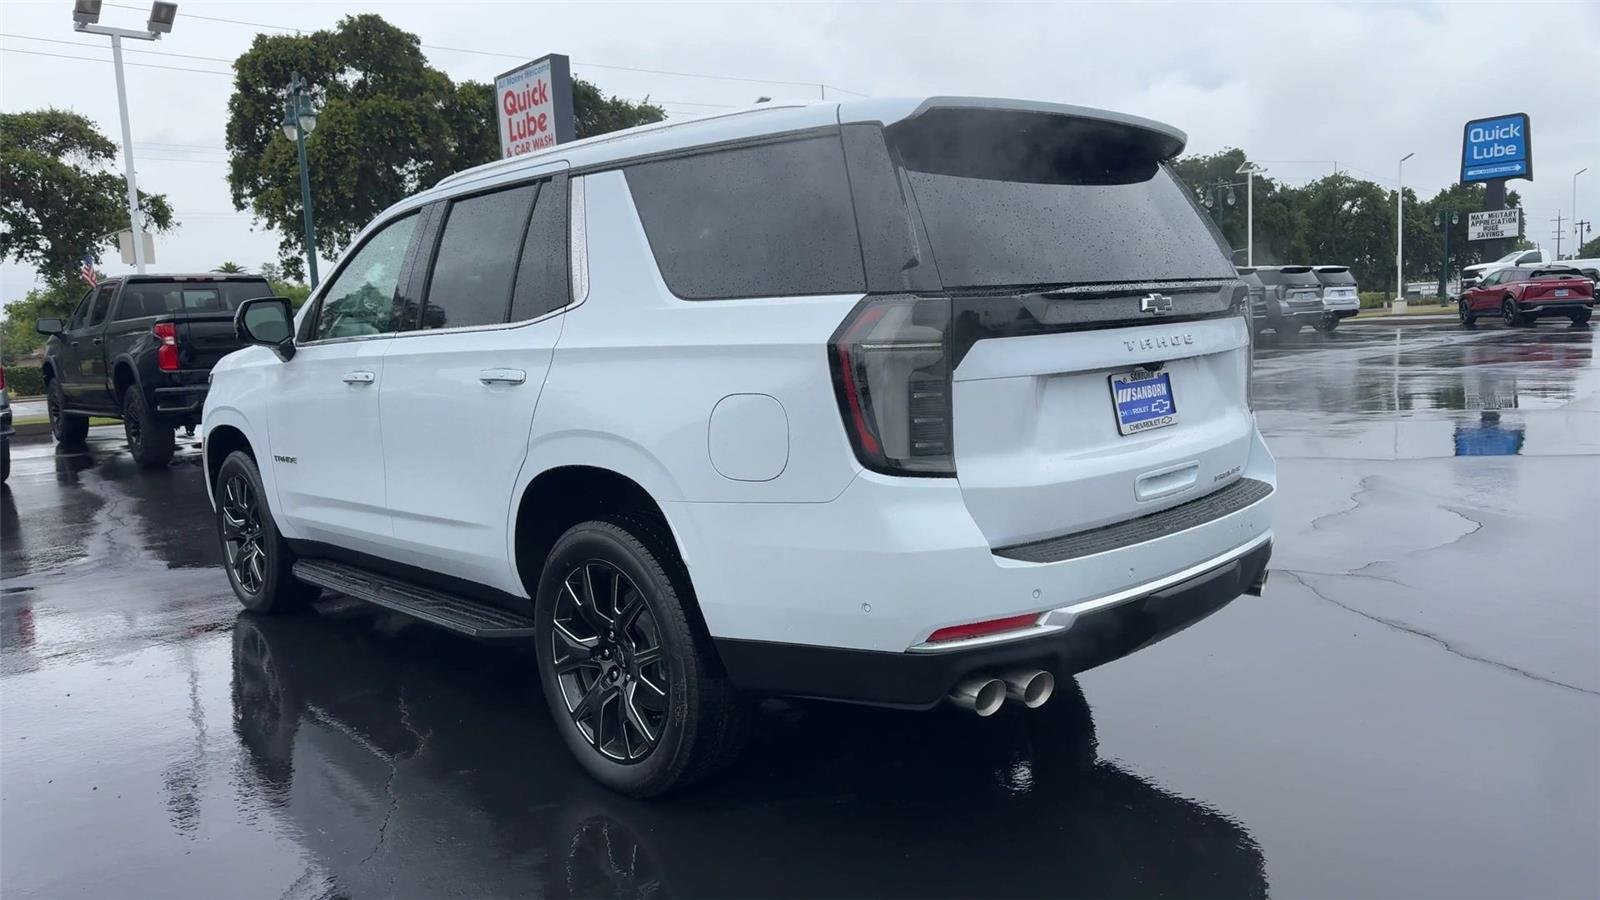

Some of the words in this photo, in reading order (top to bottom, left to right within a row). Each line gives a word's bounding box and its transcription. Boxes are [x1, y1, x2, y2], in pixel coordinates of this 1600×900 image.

[504, 79, 548, 116] Quick
[508, 112, 548, 143] Lube
[1470, 123, 1520, 143] Quick
[507, 148, 513, 158] &
[515, 141, 531, 155] CAR
[532, 134, 554, 151] WASH
[1473, 143, 1517, 160] Lube
[1471, 217, 1517, 227] APPRECIATION
[1131, 383, 1167, 401] SANBORN
[1129, 419, 1160, 431] CHEVROLET
